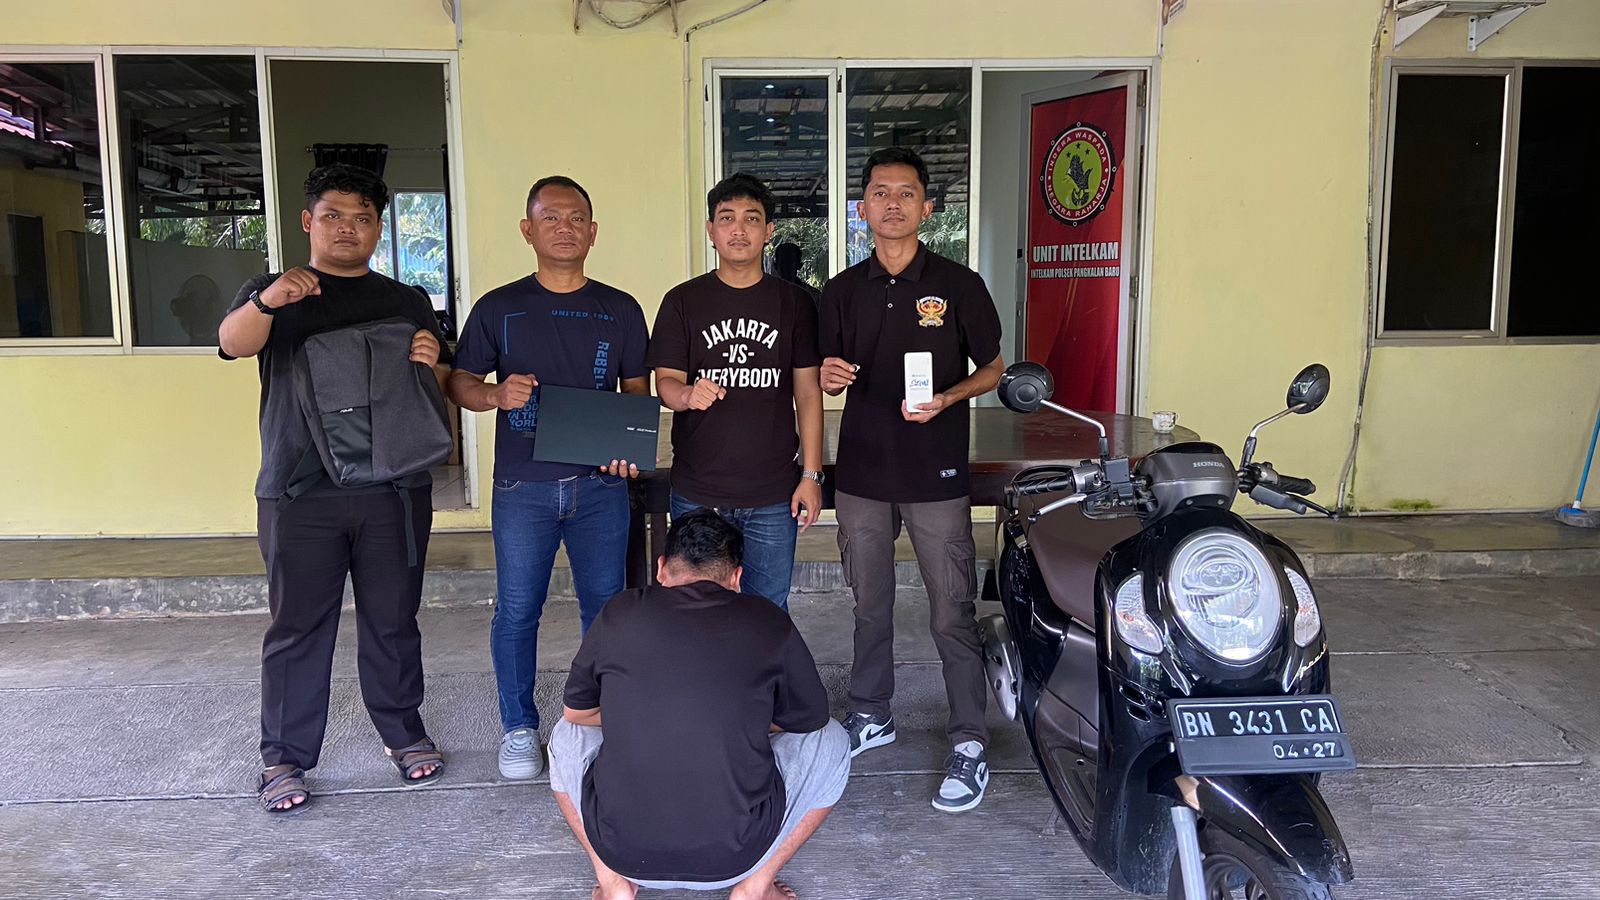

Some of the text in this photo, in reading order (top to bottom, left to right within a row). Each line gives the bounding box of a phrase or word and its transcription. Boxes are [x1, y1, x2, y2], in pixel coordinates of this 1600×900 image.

[1075, 132, 1107, 163] WASPADA
[1047, 179, 1108, 217] NEGARA RAHARJA
[1033, 241, 1119, 263] UNIT INTELKAM
[1030, 266, 1121, 279] INTELKAM POLSEK PANGKALAN BARU
[551, 309, 589, 318] UNITED
[701, 317, 779, 350] JAKARTA
[521, 411, 539, 420] TH
[1182, 706, 1335, 737] BN 3431 CA
